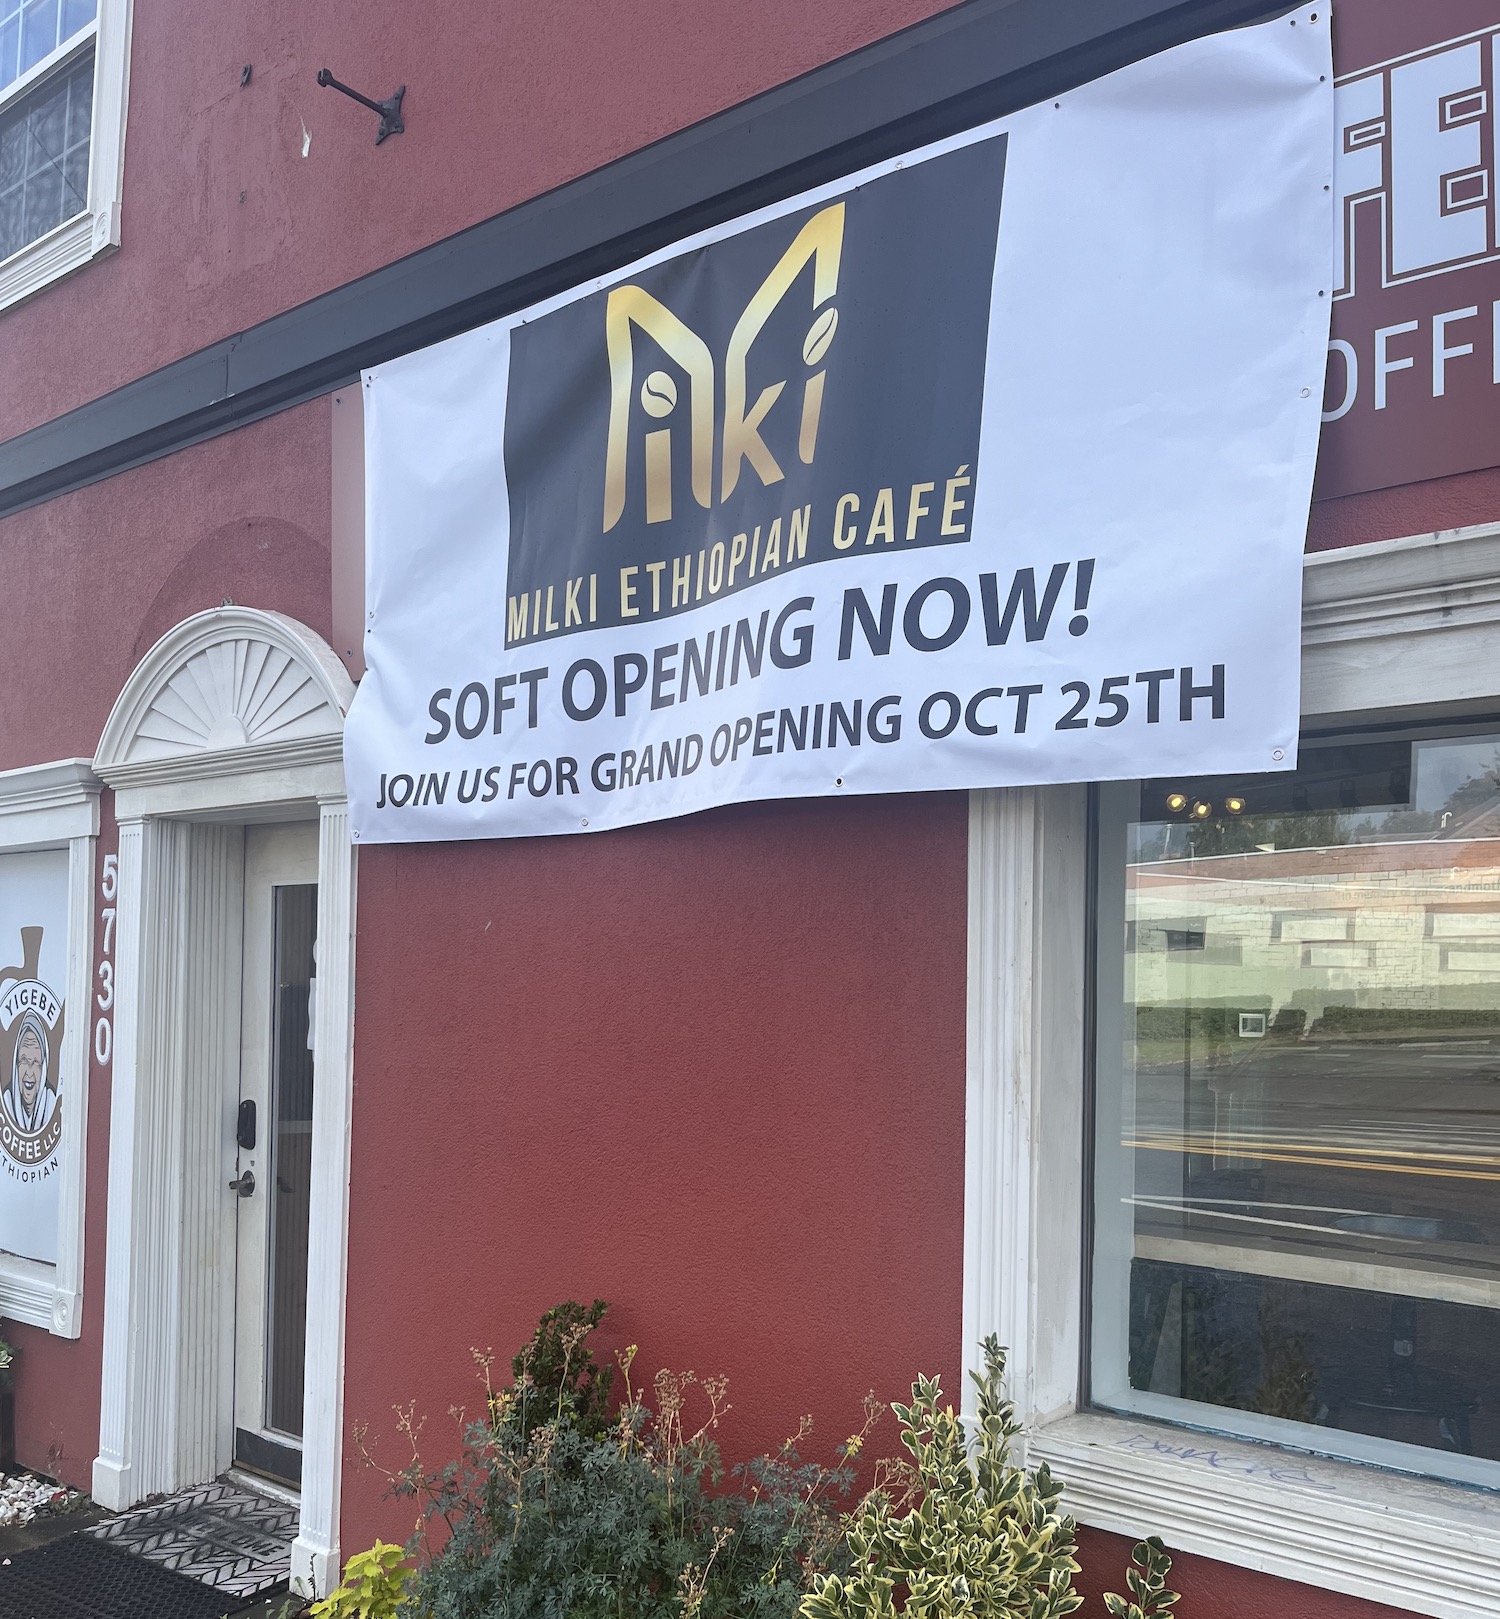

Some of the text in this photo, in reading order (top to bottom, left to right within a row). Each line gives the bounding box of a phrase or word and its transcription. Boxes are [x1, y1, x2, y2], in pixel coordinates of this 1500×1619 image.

[507, 464, 971, 643] MILKI ETHIOPIAN CAFÉ
[425, 558, 1095, 745] SOFT OPENING NOW!
[376, 664, 1225, 809] JOIN US FOR GRAND OPENING OCT 25TH
[5, 989, 56, 1021] YIGEBE
[95, 854, 117, 1065] 5730
[43, 1121, 61, 1151] LLC
